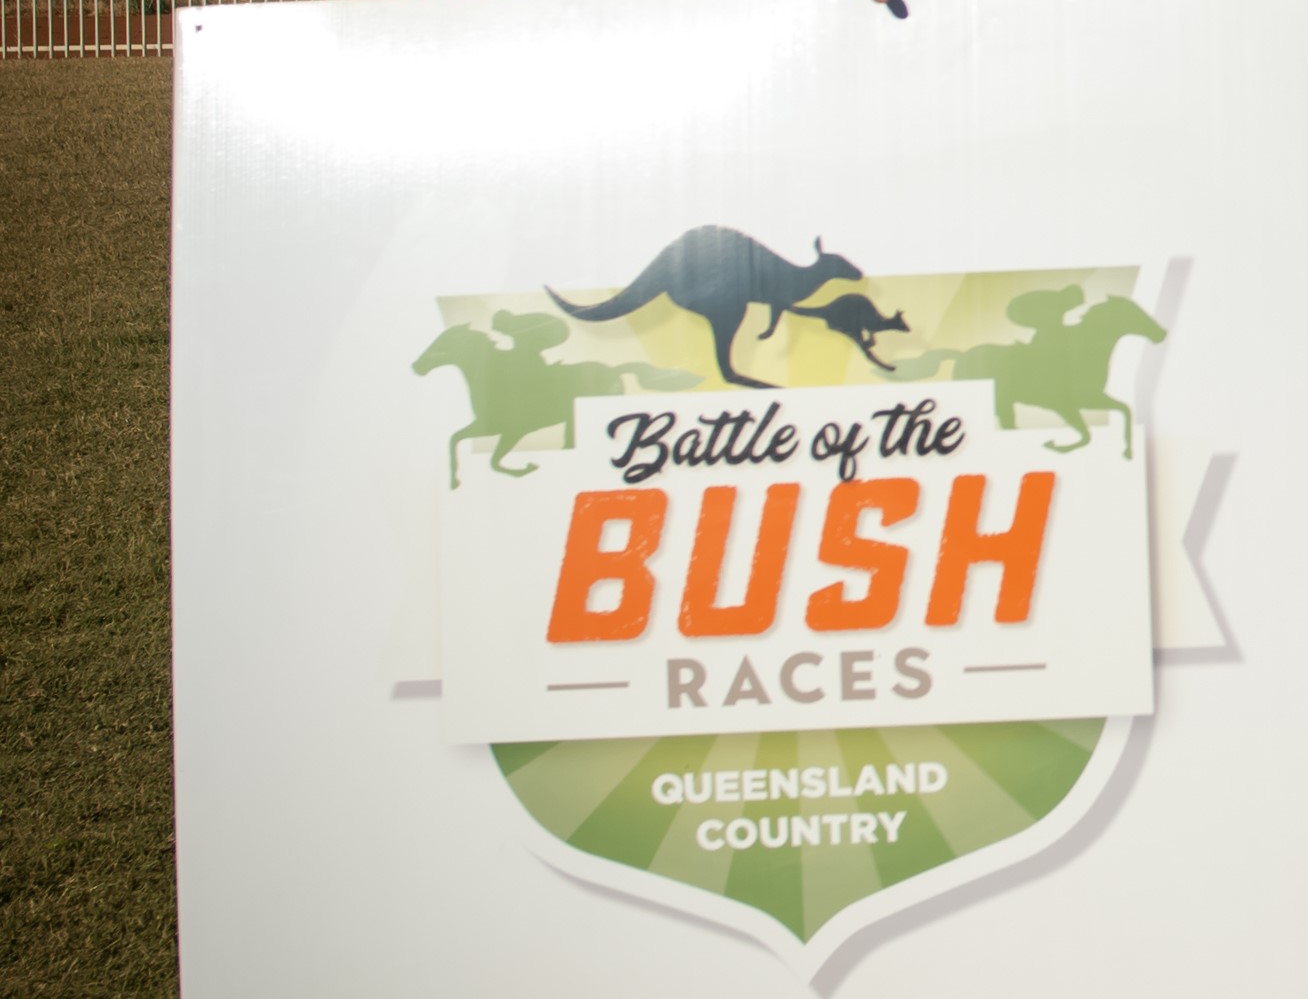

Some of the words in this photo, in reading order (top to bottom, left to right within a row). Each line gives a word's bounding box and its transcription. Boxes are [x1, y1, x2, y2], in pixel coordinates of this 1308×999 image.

[605, 401, 801, 485] Battle
[809, 419, 871, 483] of
[867, 396, 967, 458] the
[545, 470, 1058, 645] BUSH
[665, 646, 936, 710] RACES
[651, 761, 949, 805] QUEENSLAND
[696, 810, 908, 852] COUNTRY
